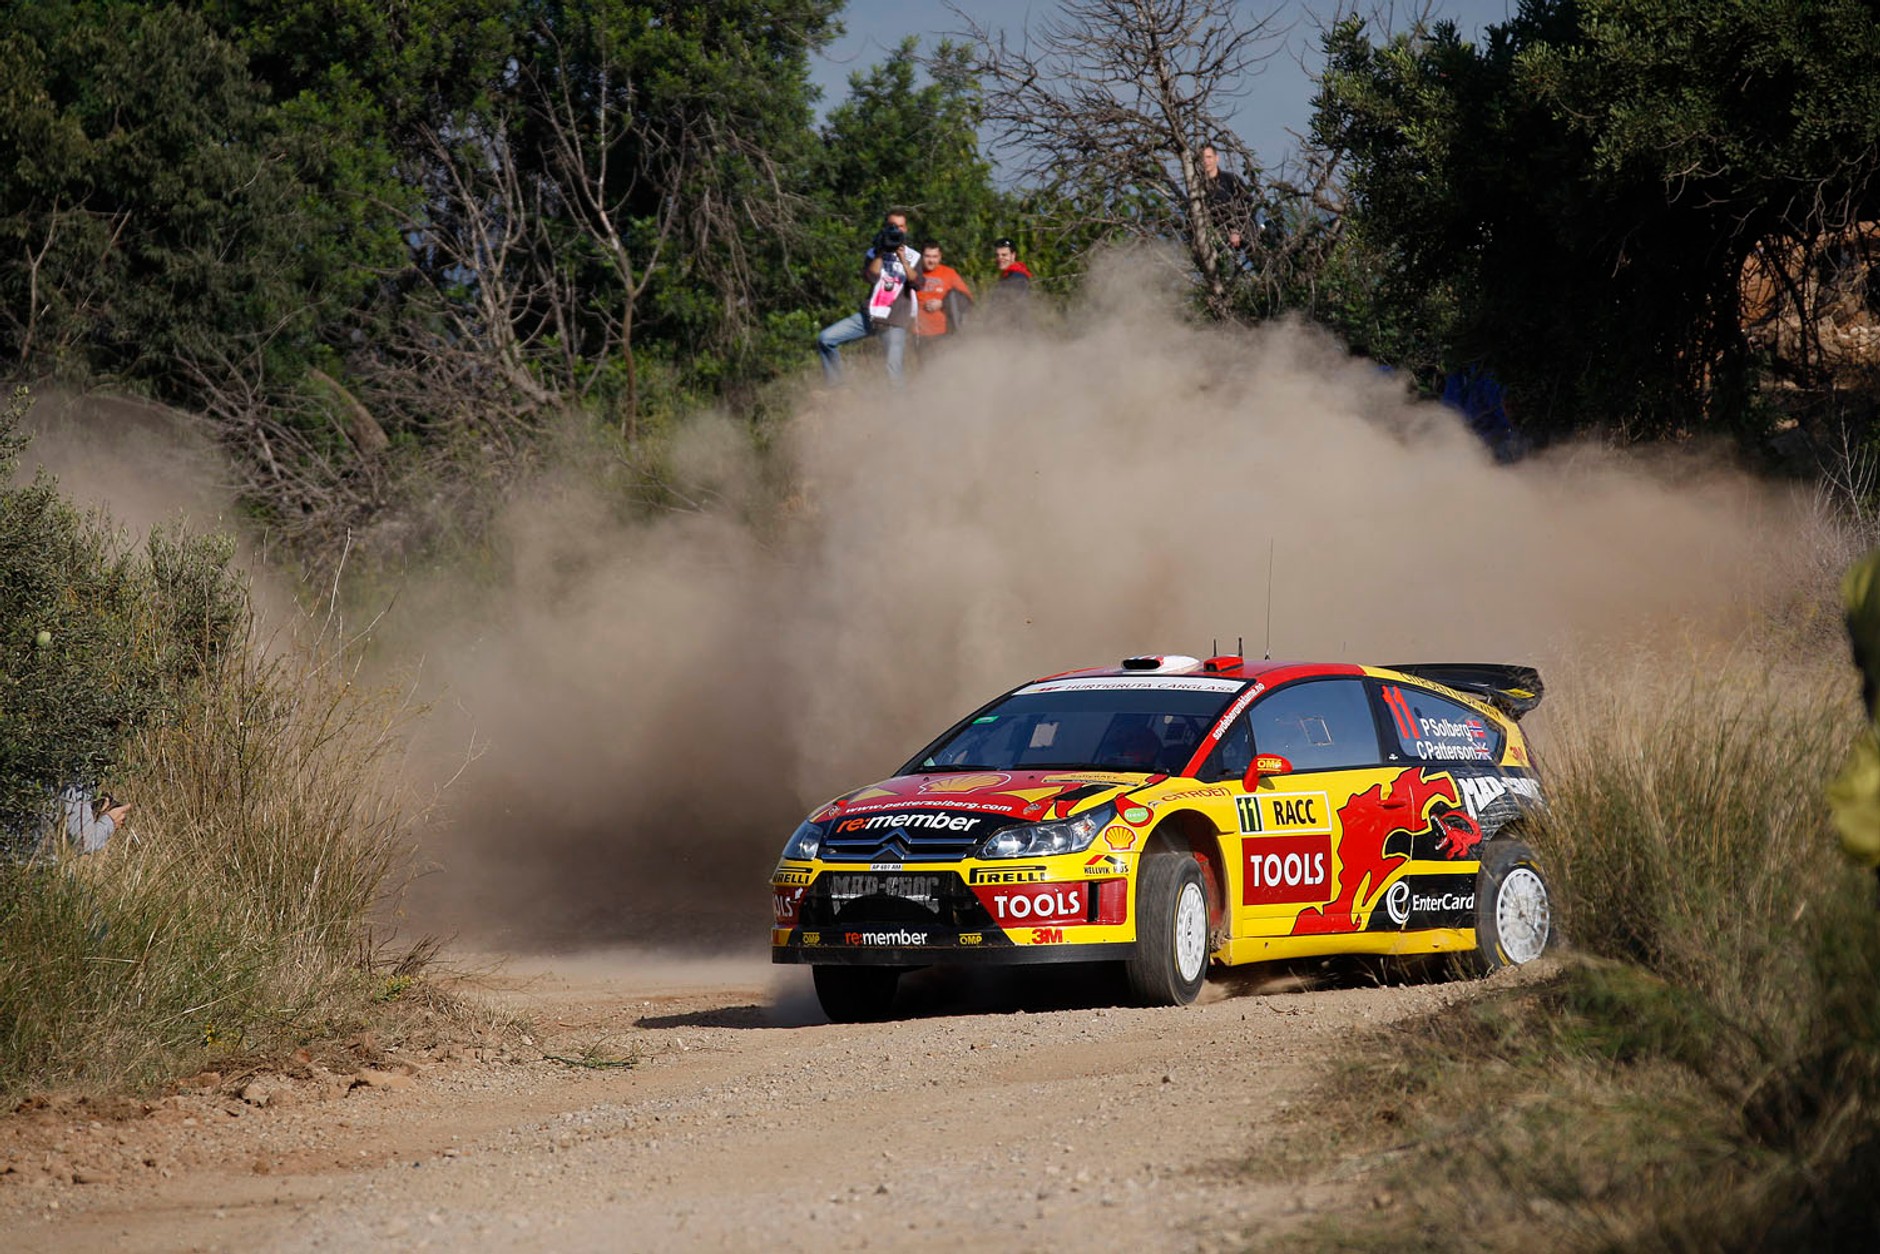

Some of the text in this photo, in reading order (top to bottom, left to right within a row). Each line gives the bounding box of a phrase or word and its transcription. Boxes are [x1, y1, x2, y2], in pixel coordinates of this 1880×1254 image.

[1157, 683, 1235, 692] CARGLASS
[1381, 685, 1420, 739] 11
[1420, 718, 1474, 742] P Solberg
[1416, 742, 1478, 760] C Patterson
[846, 799, 1013, 813] www.pettersolberg.com
[1239, 798, 1317, 832] 11 RACC
[836, 812, 981, 833] re:member
[969, 866, 1047, 885] PIRELLI
[1250, 852, 1325, 888] TOOLS
[994, 891, 1081, 919] TOOLS
[1412, 893, 1475, 912] EnterCard
[844, 928, 928, 946] re:member
[959, 932, 983, 946] OMP
[1032, 928, 1063, 945] 3M
